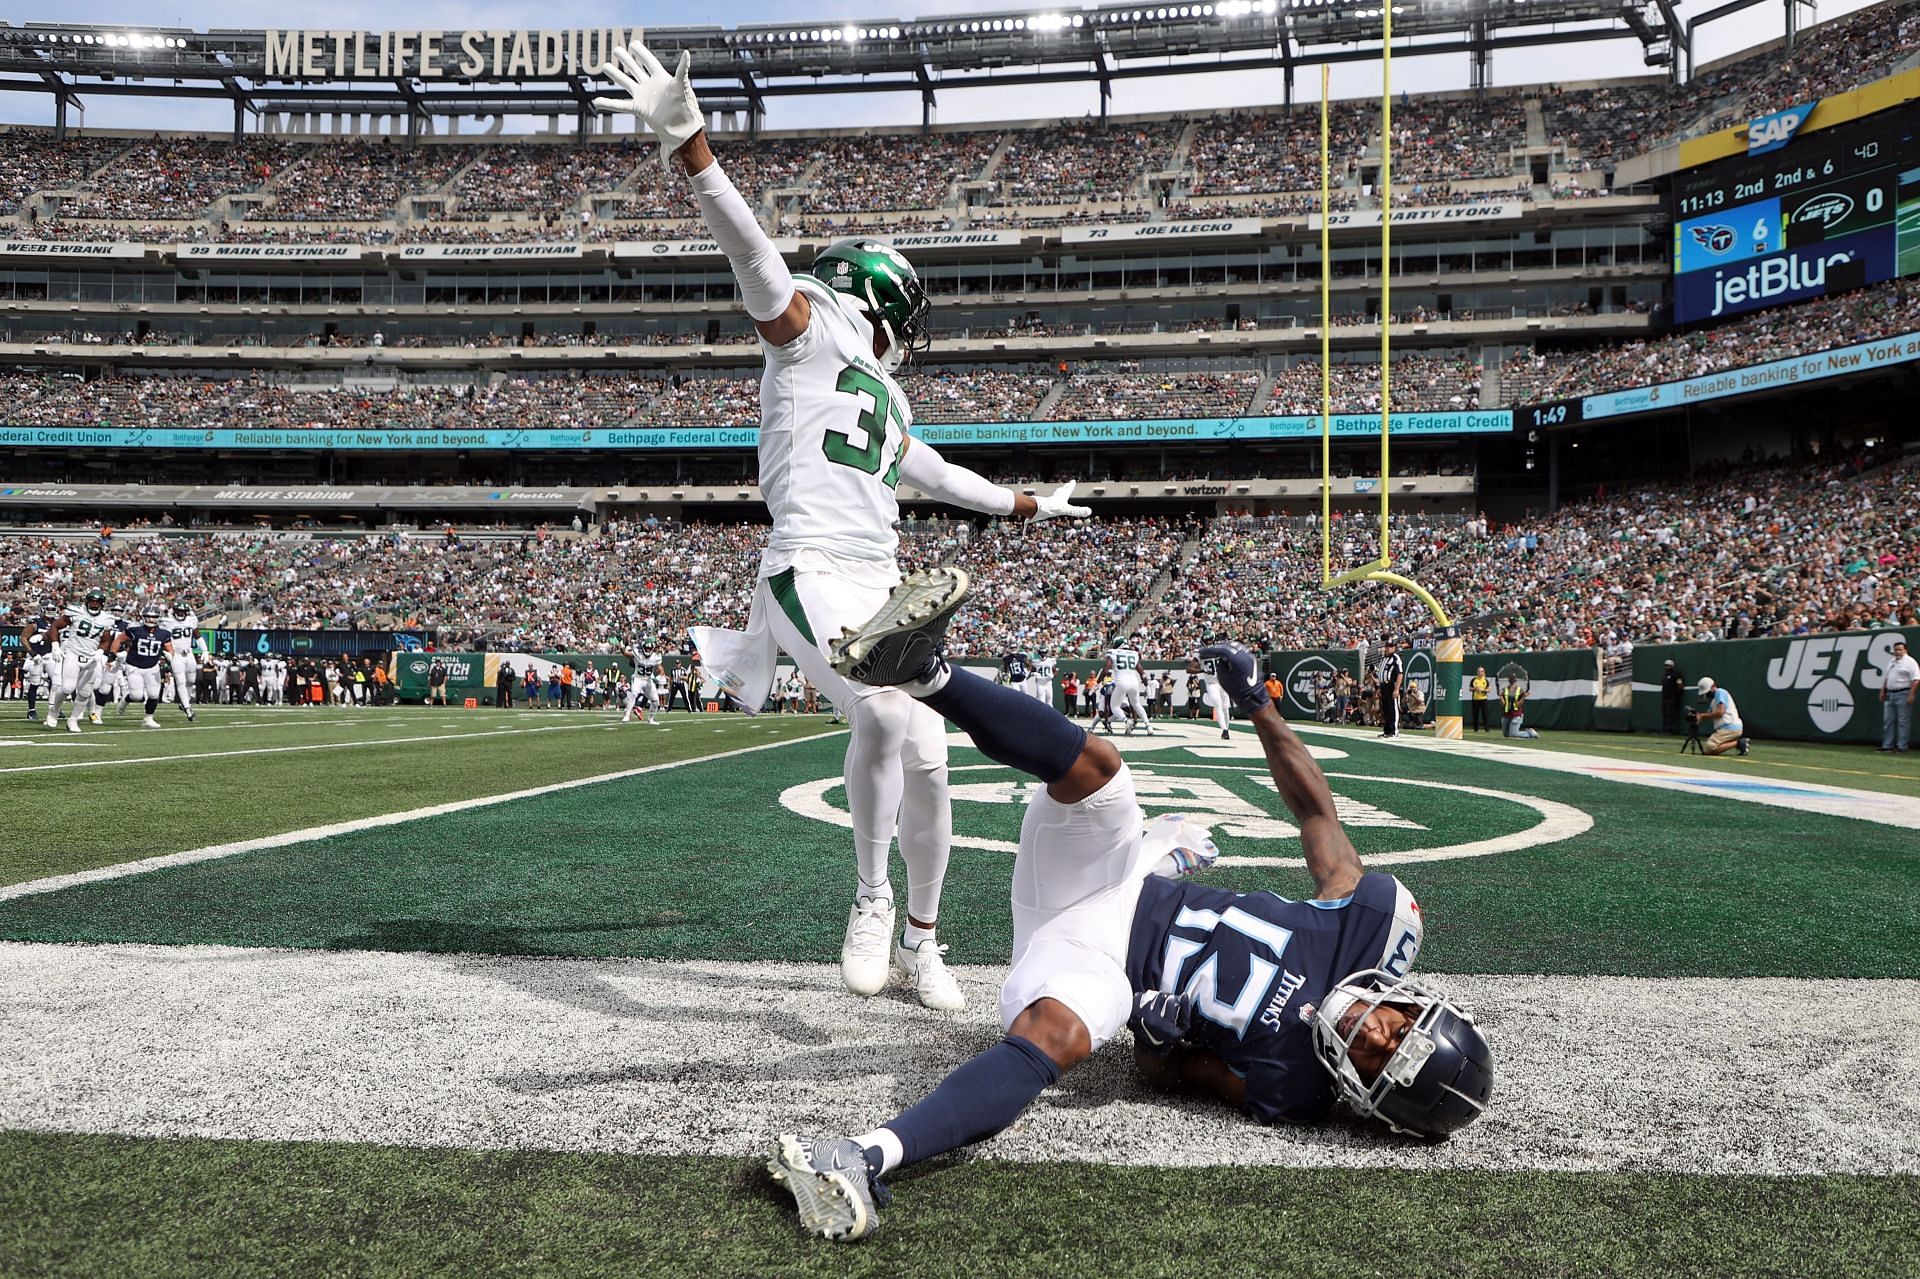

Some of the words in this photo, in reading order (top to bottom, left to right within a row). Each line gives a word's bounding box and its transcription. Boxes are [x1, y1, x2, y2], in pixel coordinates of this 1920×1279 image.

[265, 30, 443, 77] METLIFE
[1749, 114, 1799, 148] SAP
[1854, 141, 1878, 159] 40
[1680, 190, 1725, 213] 11:13
[1734, 179, 1765, 200] 2nd
[1774, 168, 1802, 189] 2nd
[1806, 168, 1816, 179] &
[1823, 159, 1834, 175] 6
[1865, 188, 1884, 212] 0
[1444, 206, 1503, 218] LYONS
[1088, 229, 1108, 238] 73
[1135, 226, 1166, 236] JOE
[1169, 223, 1232, 233] KLECKO
[1752, 218, 1768, 240] 6
[893, 235, 962, 246] WINSTON
[965, 234, 1000, 243] HILL
[6, 243, 47, 252] WEEB
[49, 245, 113, 254] EWBANK
[189, 247, 210, 255] 99
[216, 247, 260, 255] MARK
[264, 247, 348, 256] GASTINEAU
[442, 247, 490, 255] LARRY
[493, 246, 577, 255] GRANTHAM
[1684, 378, 1736, 398] Reliable
[1741, 365, 1798, 387] banking
[1802, 360, 1823, 375] for
[1828, 353, 1862, 369] New
[1867, 343, 1902, 361] York
[1408, 416, 1461, 430] Federal
[1466, 415, 1510, 428] Credit
[1533, 405, 1567, 426] 1:49
[0, 430, 33, 441] deral
[37, 431, 73, 442] Credit
[78, 431, 112, 442] Union
[608, 432, 665, 446] Bethpage
[669, 432, 715, 443] Federal
[719, 431, 756, 442] Credit
[922, 428, 972, 440] Reliable
[976, 427, 1027, 441] banking
[1030, 426, 1048, 438] for
[1052, 426, 1080, 437] New
[1084, 425, 1113, 437] York
[1117, 425, 1142, 436] and
[1146, 423, 1199, 439] beyond.
[235, 433, 282, 444] Reliable
[286, 433, 333, 447] banking
[336, 433, 352, 444] for
[356, 434, 382, 444] New
[386, 433, 412, 444] York
[416, 433, 438, 444] and
[442, 433, 488, 447] beyond.
[1184, 485, 1226, 495] verizon
[1355, 482, 1372, 490] SAP
[214, 491, 282, 499] METLIFE
[283, 491, 355, 500] STADIUM
[76, 619, 105, 638] 97
[216, 631, 233, 640] TOL
[222, 641, 231, 653] 3
[257, 633, 270, 653] 6
[1116, 654, 1136, 670] 56
[1766, 632, 1906, 690] JETS
[527, 671, 534, 681] K
[1162, 904, 1293, 1041] 12
[1258, 968, 1306, 1033] TITANS
